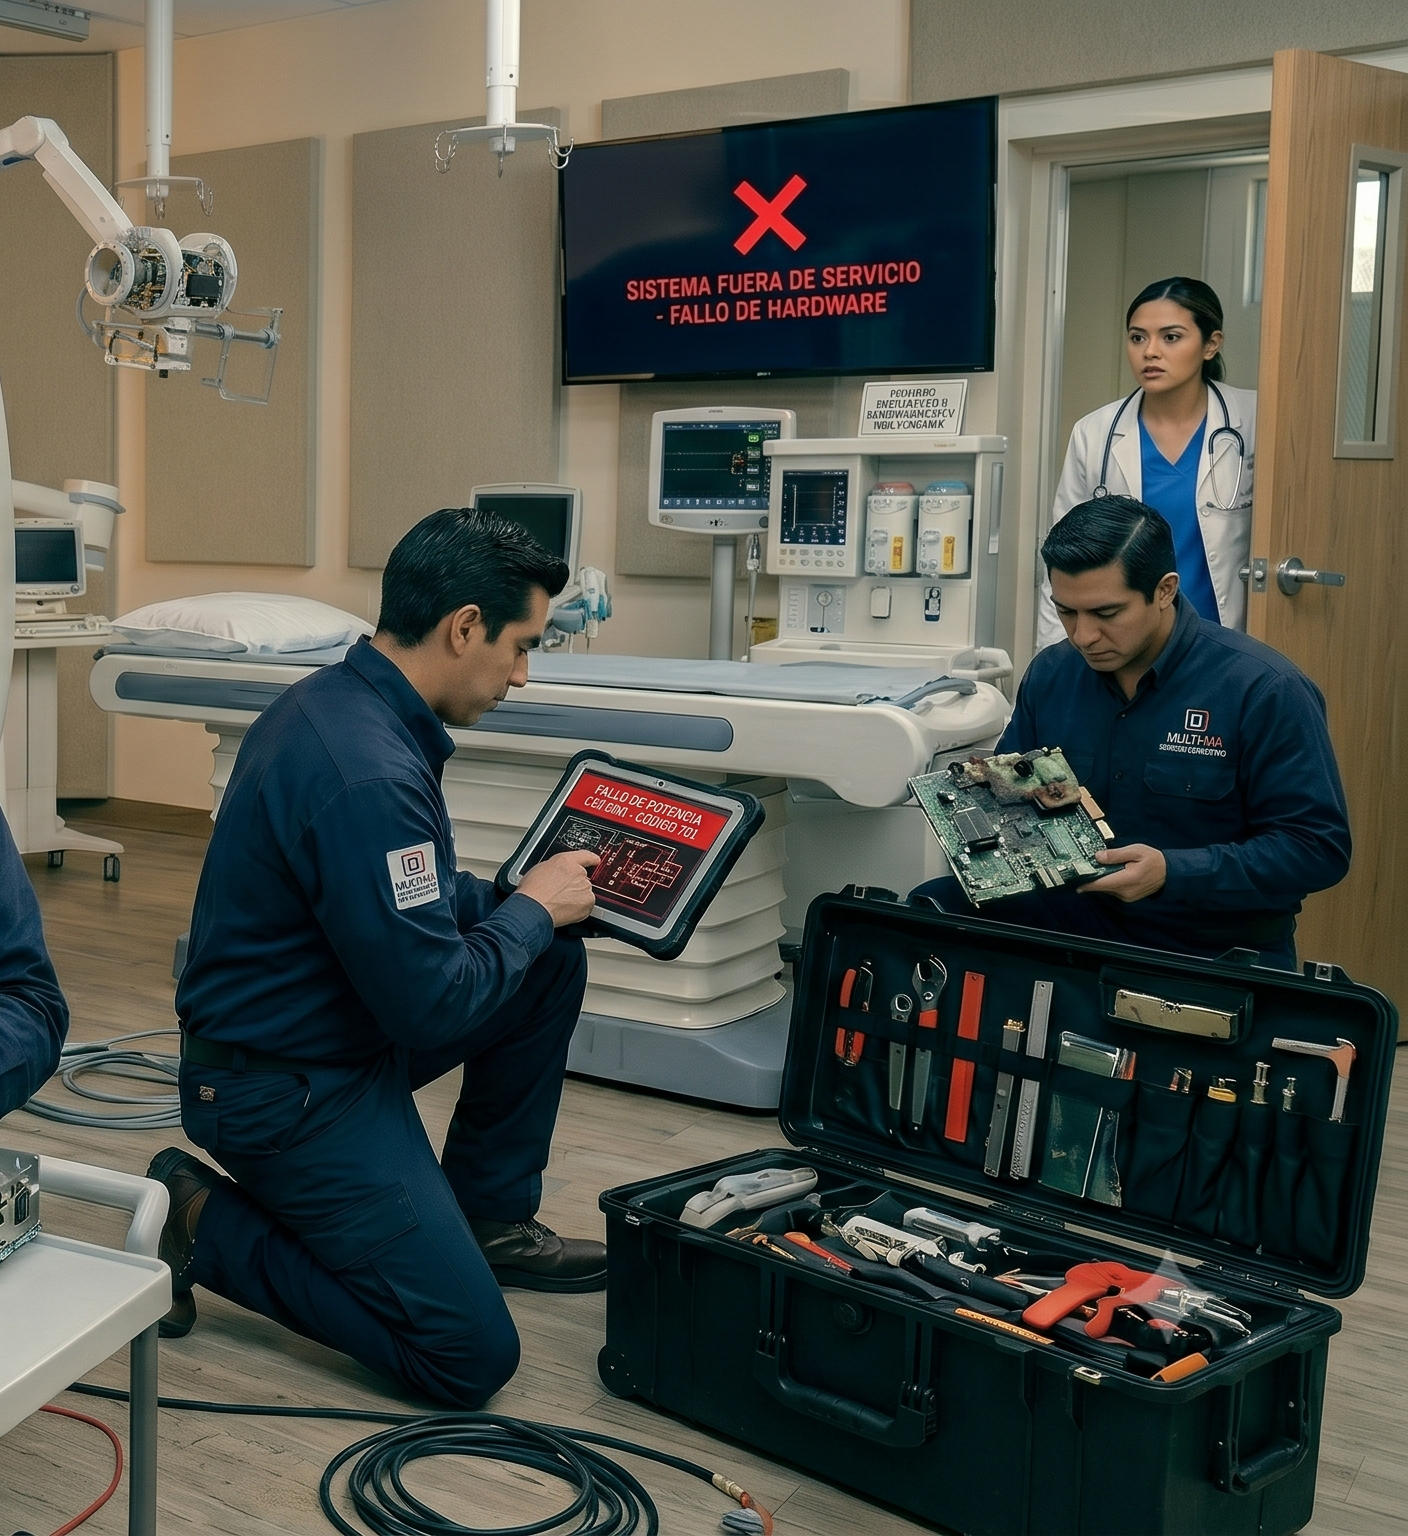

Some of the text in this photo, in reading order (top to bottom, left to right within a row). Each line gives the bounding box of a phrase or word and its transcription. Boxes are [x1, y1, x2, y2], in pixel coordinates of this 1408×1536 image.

[626, 260, 921, 301] SISTEMA FUERA DE SERVICIO
[669, 301, 729, 326] FALLO
[735, 299, 761, 321] DE
[767, 292, 888, 319] HARDWARE
[594, 784, 703, 826] FALLO DE POTENCIA
[677, 825, 699, 841] 701
